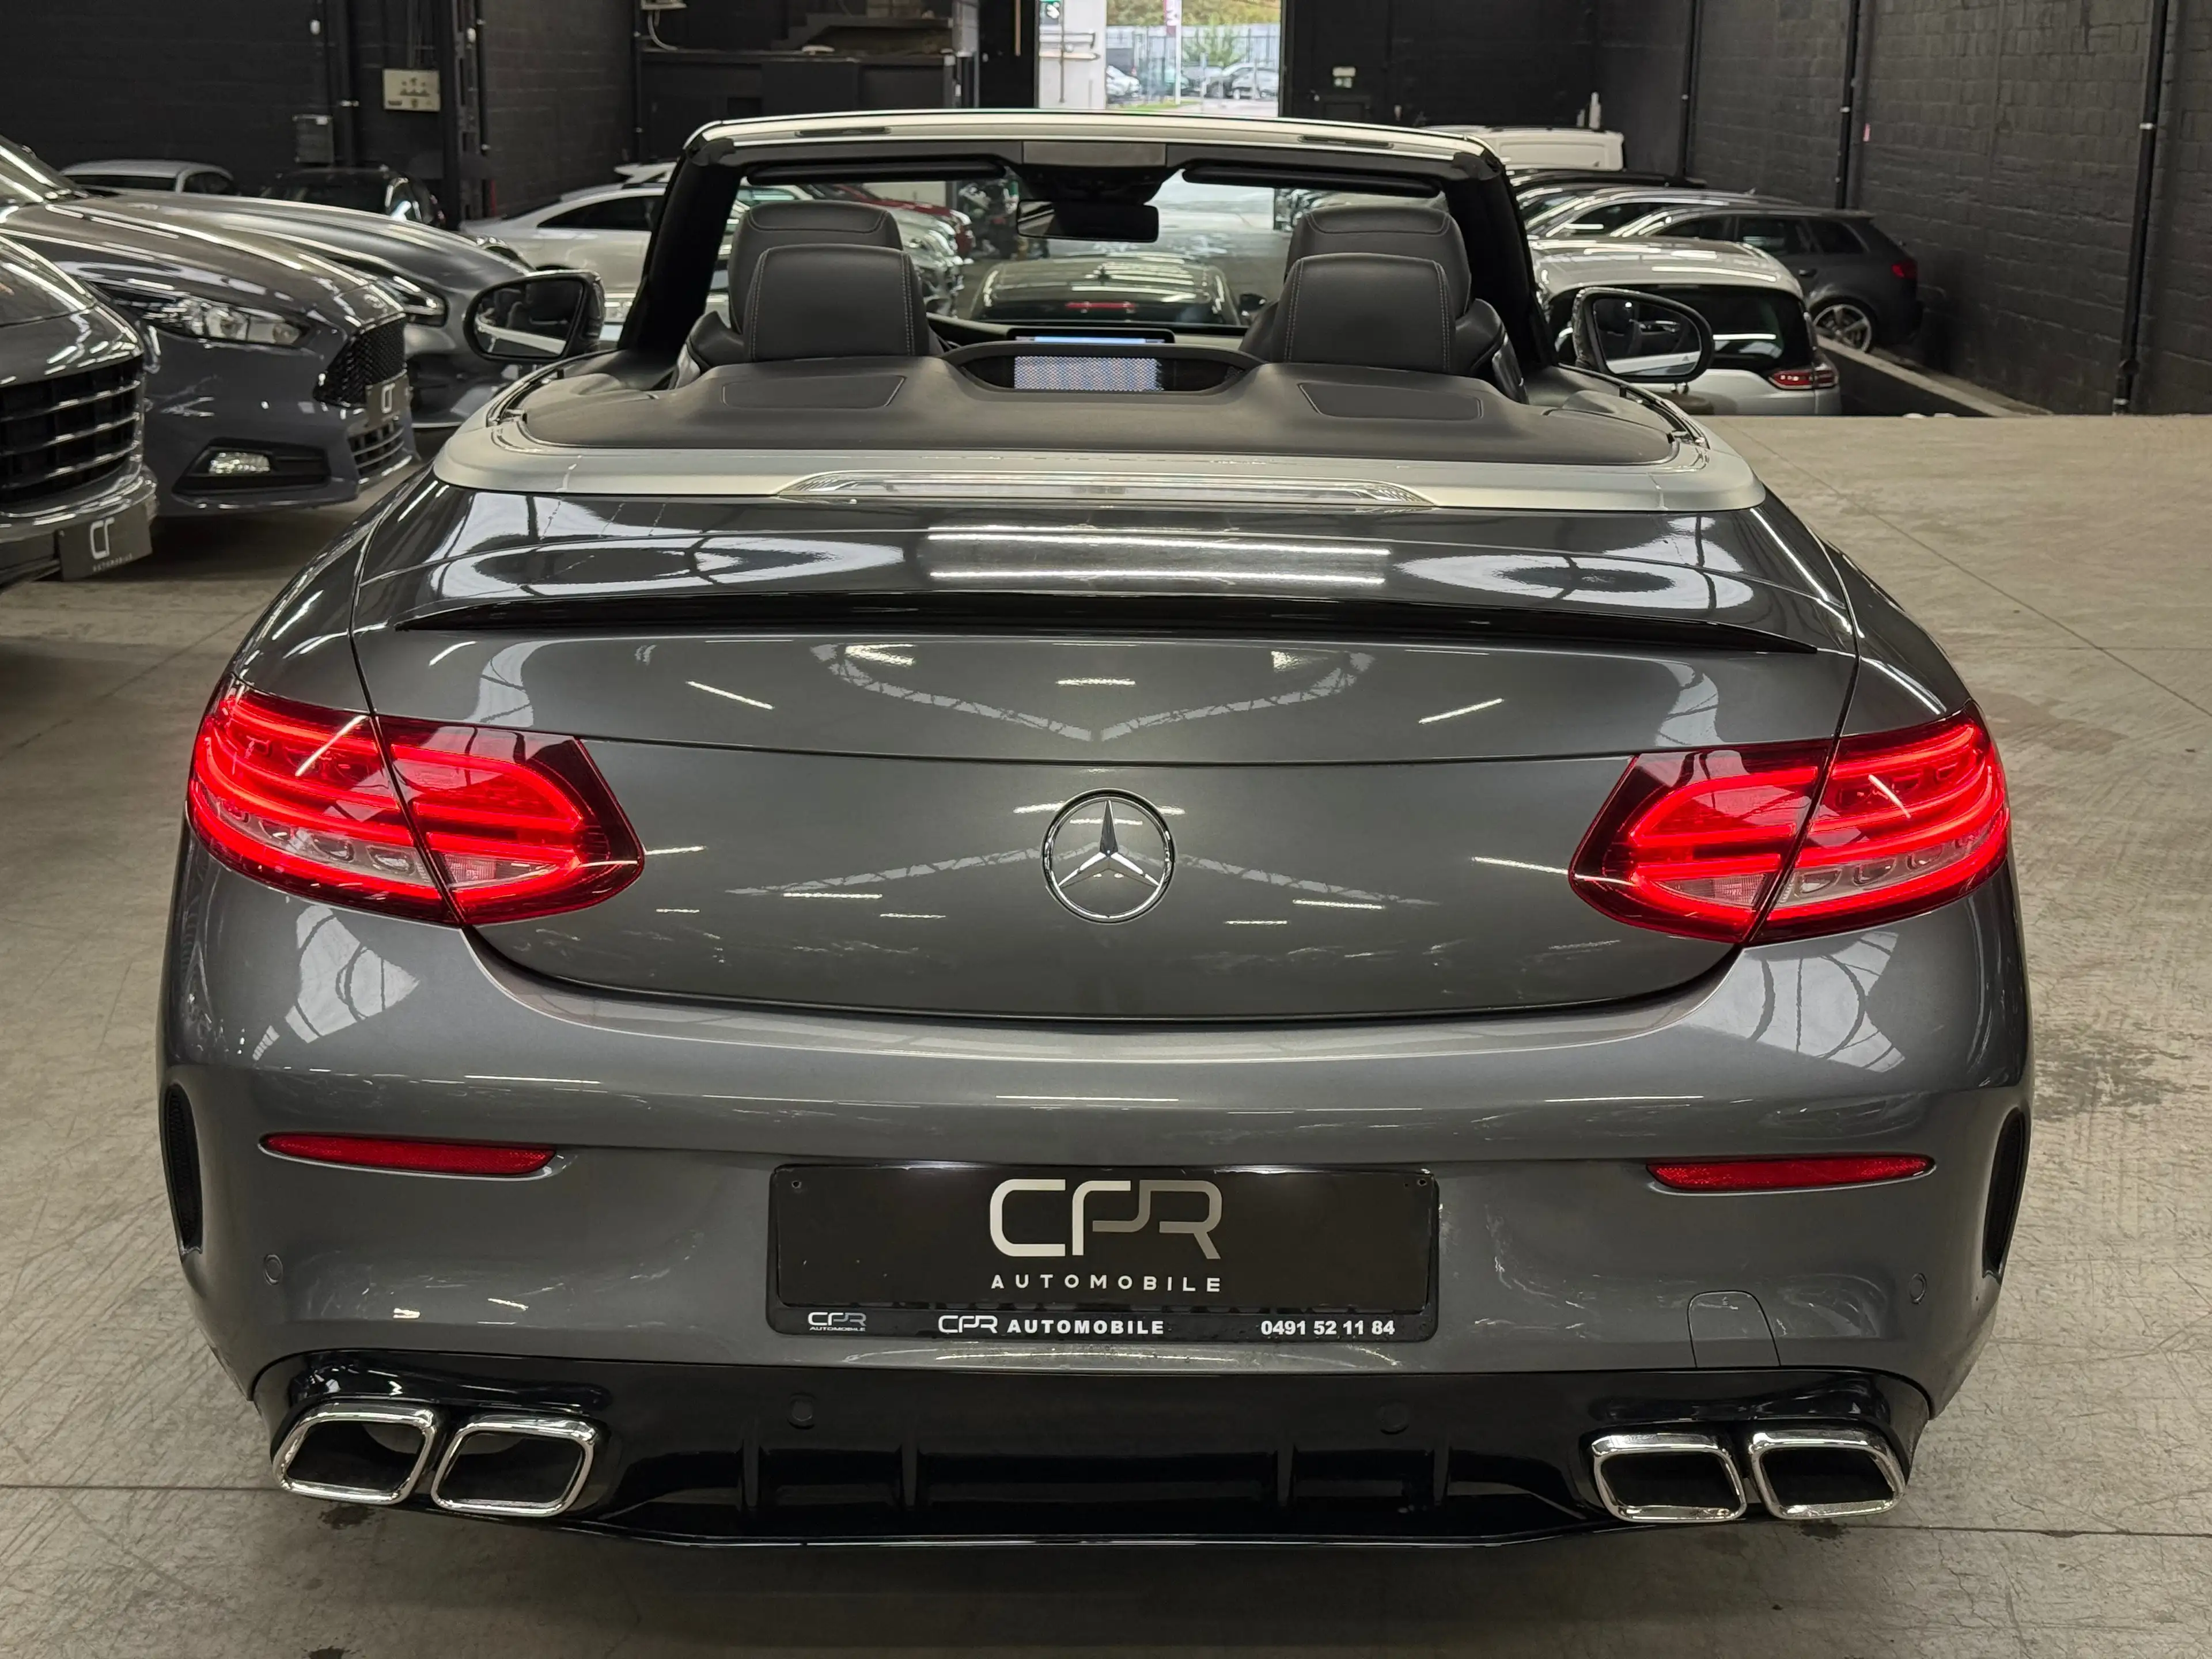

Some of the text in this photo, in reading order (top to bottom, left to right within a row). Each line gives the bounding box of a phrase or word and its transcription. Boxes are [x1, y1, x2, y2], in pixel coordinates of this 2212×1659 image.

[990, 1179, 1222, 1259] CPR
[991, 1274, 1221, 1292] AUTOMOBILE
[808, 1312, 867, 1327] CPR
[938, 1315, 1164, 1335] CPR AUTOMOBILE
[1260, 1320, 1396, 1335] 0491 52 11 84
